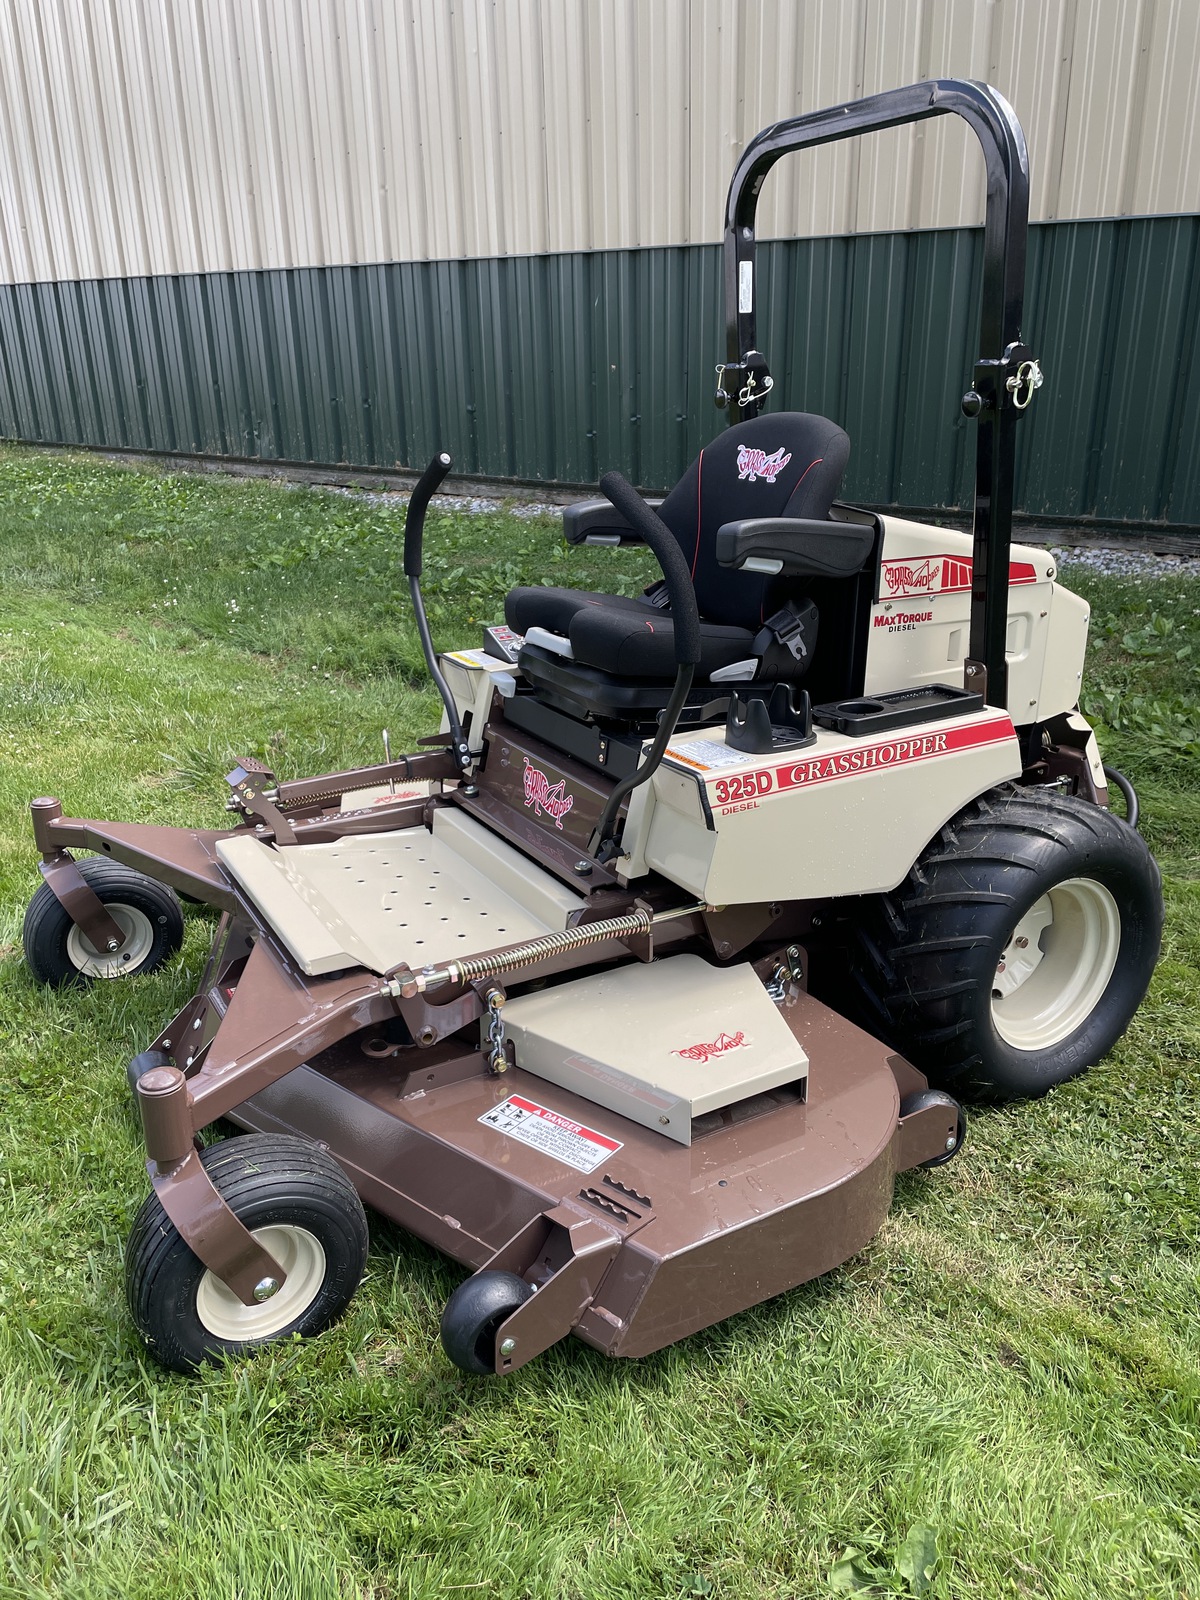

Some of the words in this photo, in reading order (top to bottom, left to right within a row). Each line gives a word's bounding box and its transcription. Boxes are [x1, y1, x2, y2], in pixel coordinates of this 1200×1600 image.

[888, 623, 917, 632] DIESEL
[715, 771, 773, 803] 325D
[790, 734, 948, 784] GRASSHOPPER
[721, 801, 760, 816] DIESEL
[543, 1113, 582, 1132] DANGER
[553, 1125, 567, 1133] KEEP
